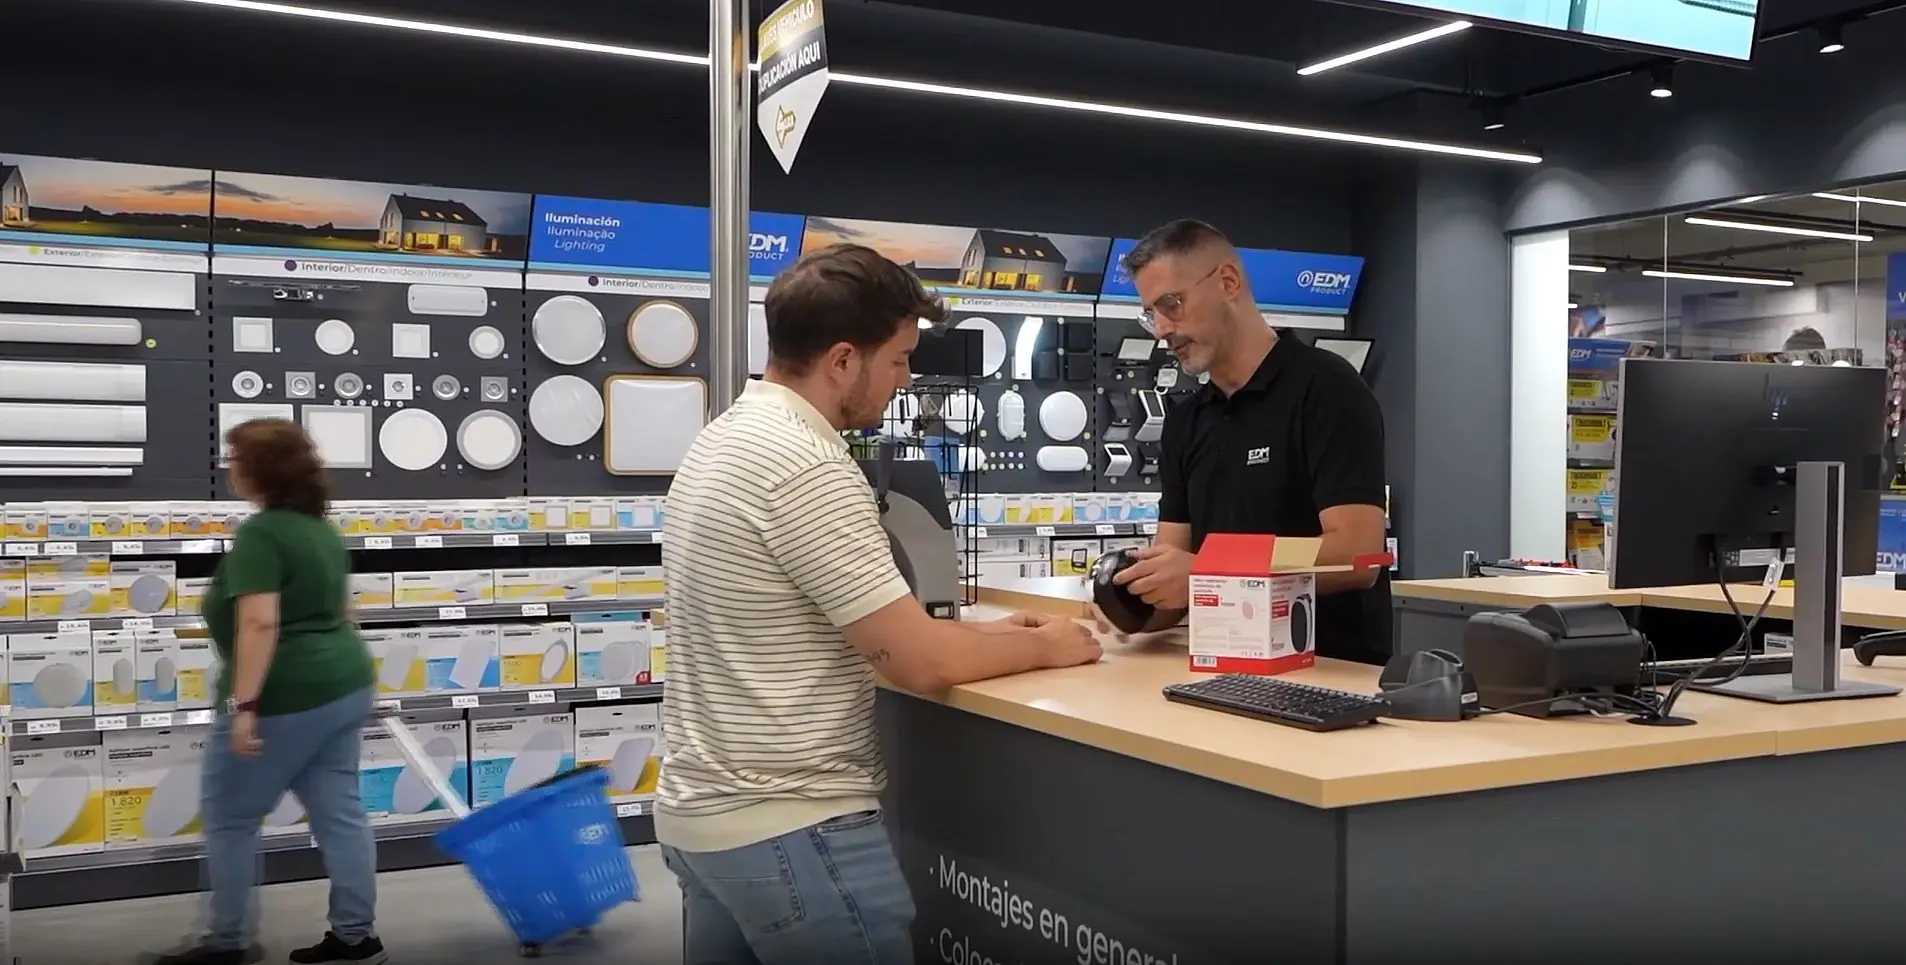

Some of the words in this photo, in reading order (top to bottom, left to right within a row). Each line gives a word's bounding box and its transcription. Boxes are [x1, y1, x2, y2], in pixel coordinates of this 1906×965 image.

[545, 212, 621, 228] Iluminación
[547, 225, 616, 241] Iluminação
[554, 239, 606, 253] Lighting
[748, 232, 788, 253] DM
[749, 251, 785, 261] ODUCT
[1312, 272, 1352, 289] EDM
[1248, 446, 1270, 461] EDM
[1247, 579, 1266, 588] EDM
[73, 748, 96, 758] EDM
[939, 854, 1034, 929] Montajes
[1039, 908, 1069, 948] en
[1076, 924, 1178, 965] gene
